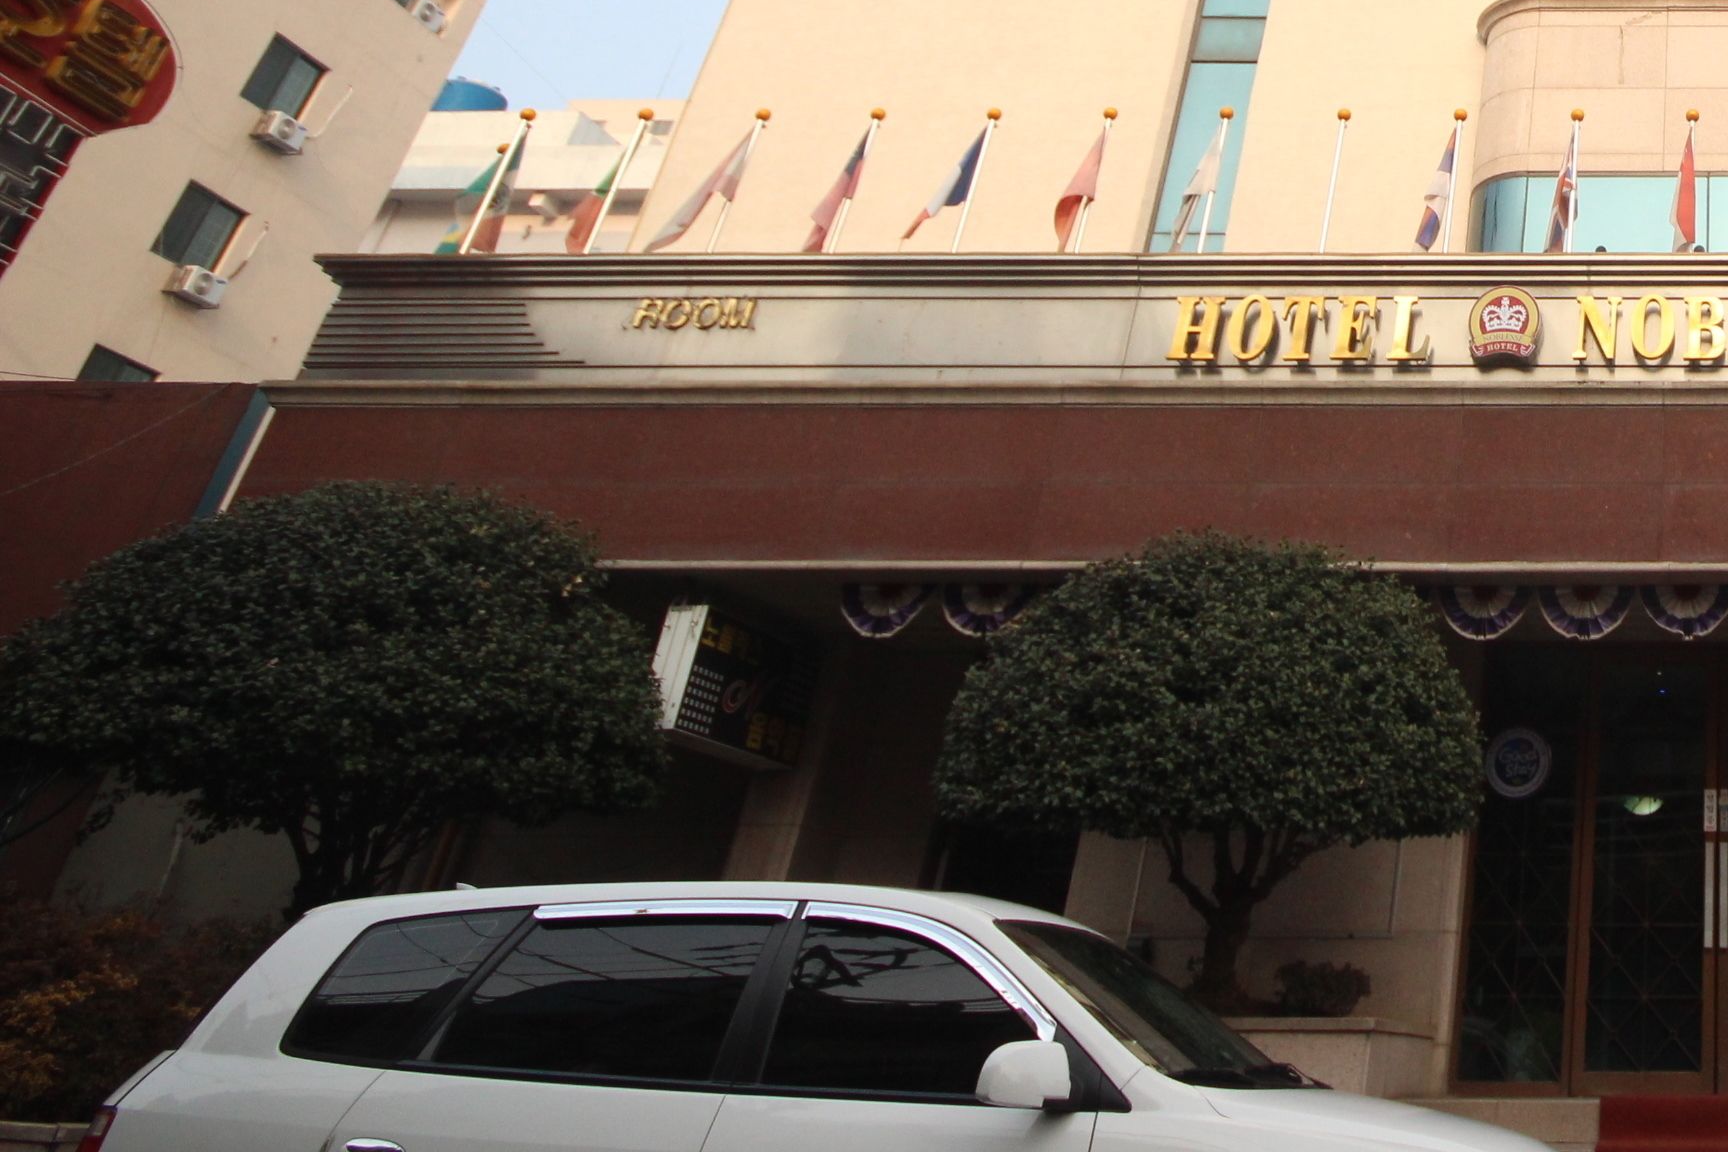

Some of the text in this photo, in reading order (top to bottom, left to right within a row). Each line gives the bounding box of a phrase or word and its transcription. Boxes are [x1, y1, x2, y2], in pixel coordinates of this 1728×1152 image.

[631, 296, 758, 331] ROOM
[1164, 295, 1433, 363] HOTEL
[1486, 343, 1519, 352] HOTEL
